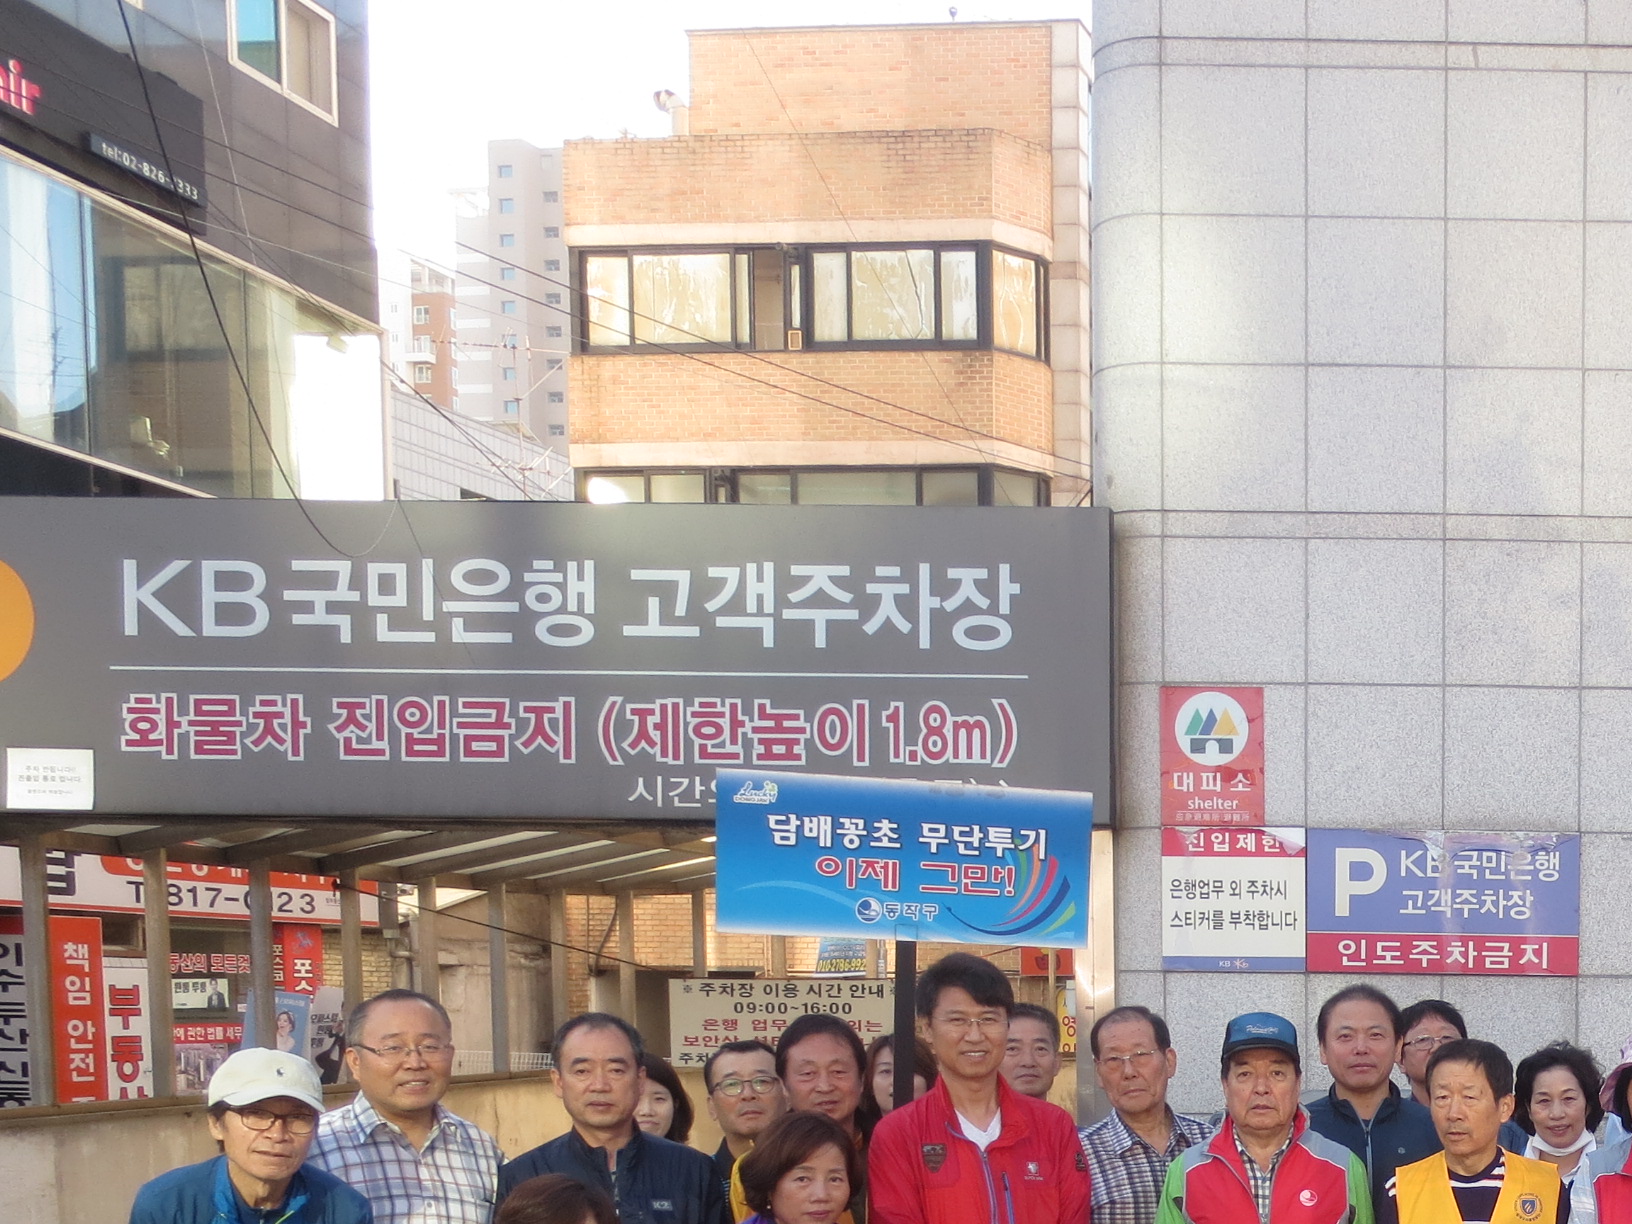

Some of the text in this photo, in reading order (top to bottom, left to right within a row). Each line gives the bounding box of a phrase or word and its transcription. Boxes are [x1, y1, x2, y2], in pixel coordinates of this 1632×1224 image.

[122, 557, 1021, 651] KB국민은행 고객주차장
[120, 692, 311, 761] 화물차
[328, 695, 576, 763] 진입금지
[1173, 771, 1251, 793] 대피소
[1187, 796, 1239, 811] shelter
[767, 813, 1048, 860] 담배꽁초 무단투기
[816, 855, 1017, 897] 이제 그만!
[1453, 851, 1560, 882] 국민은행
[1169, 878, 1288, 900] 은행업무 외 주차시
[1334, 847, 1388, 917] P
[883, 902, 939, 922] 동작구
[1399, 889, 1534, 920] 고객주차장
[1169, 910, 1298, 931] 스티커를 부착합니다
[1337, 939, 1549, 969] 인도주차금지
[63, 942, 92, 1005] 책임
[699, 982, 885, 999] 주차장 이용 시간 안내
[733, 1001, 853, 1015] 09:00~16:00
[187, 1027, 205, 1041] 관한
[207, 1026, 224, 1041] 법률
[702, 1019, 739, 1032] 은행
[752, 1019, 789, 1032] 업무
[67, 1020, 96, 1083] 안전
